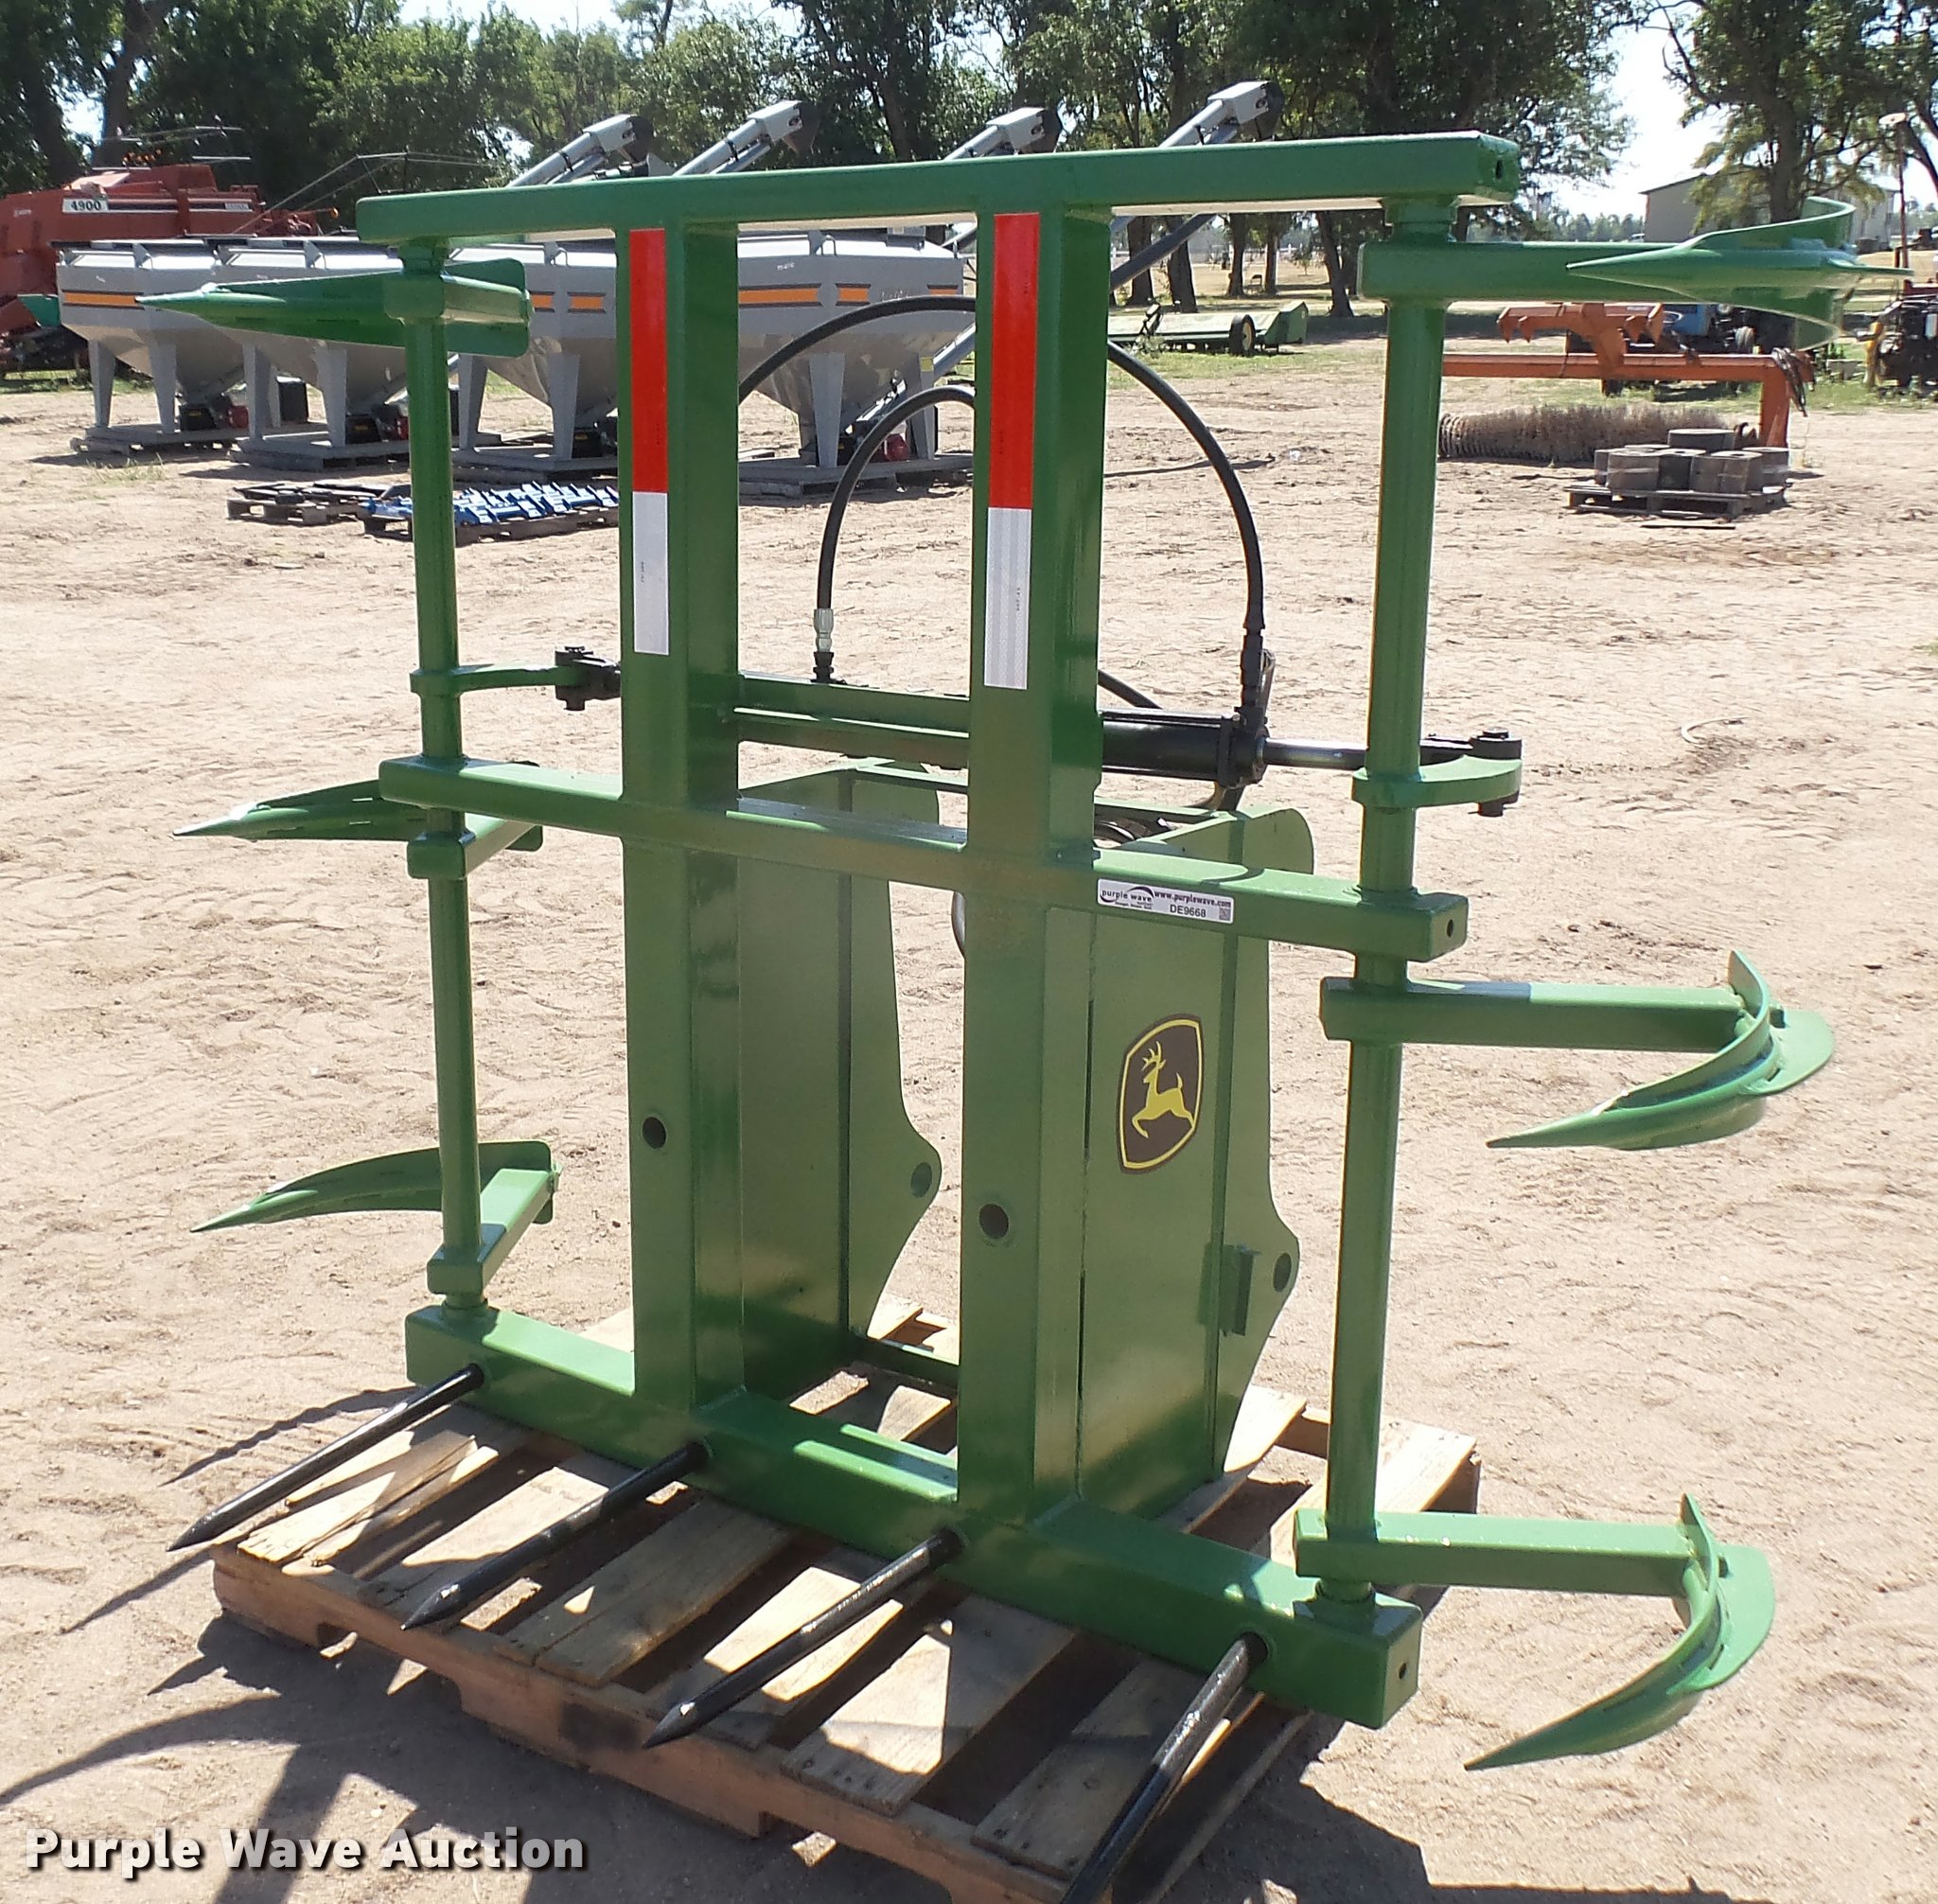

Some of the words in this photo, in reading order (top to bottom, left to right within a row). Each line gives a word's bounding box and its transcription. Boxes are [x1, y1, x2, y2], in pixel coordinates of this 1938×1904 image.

[71, 200, 102, 211] 4900
[1101, 889, 1128, 900] purple
[1131, 893, 1153, 903] wave
[1154, 890, 1231, 908] www.purplewave.com
[1170, 904, 1207, 918] DE9668
